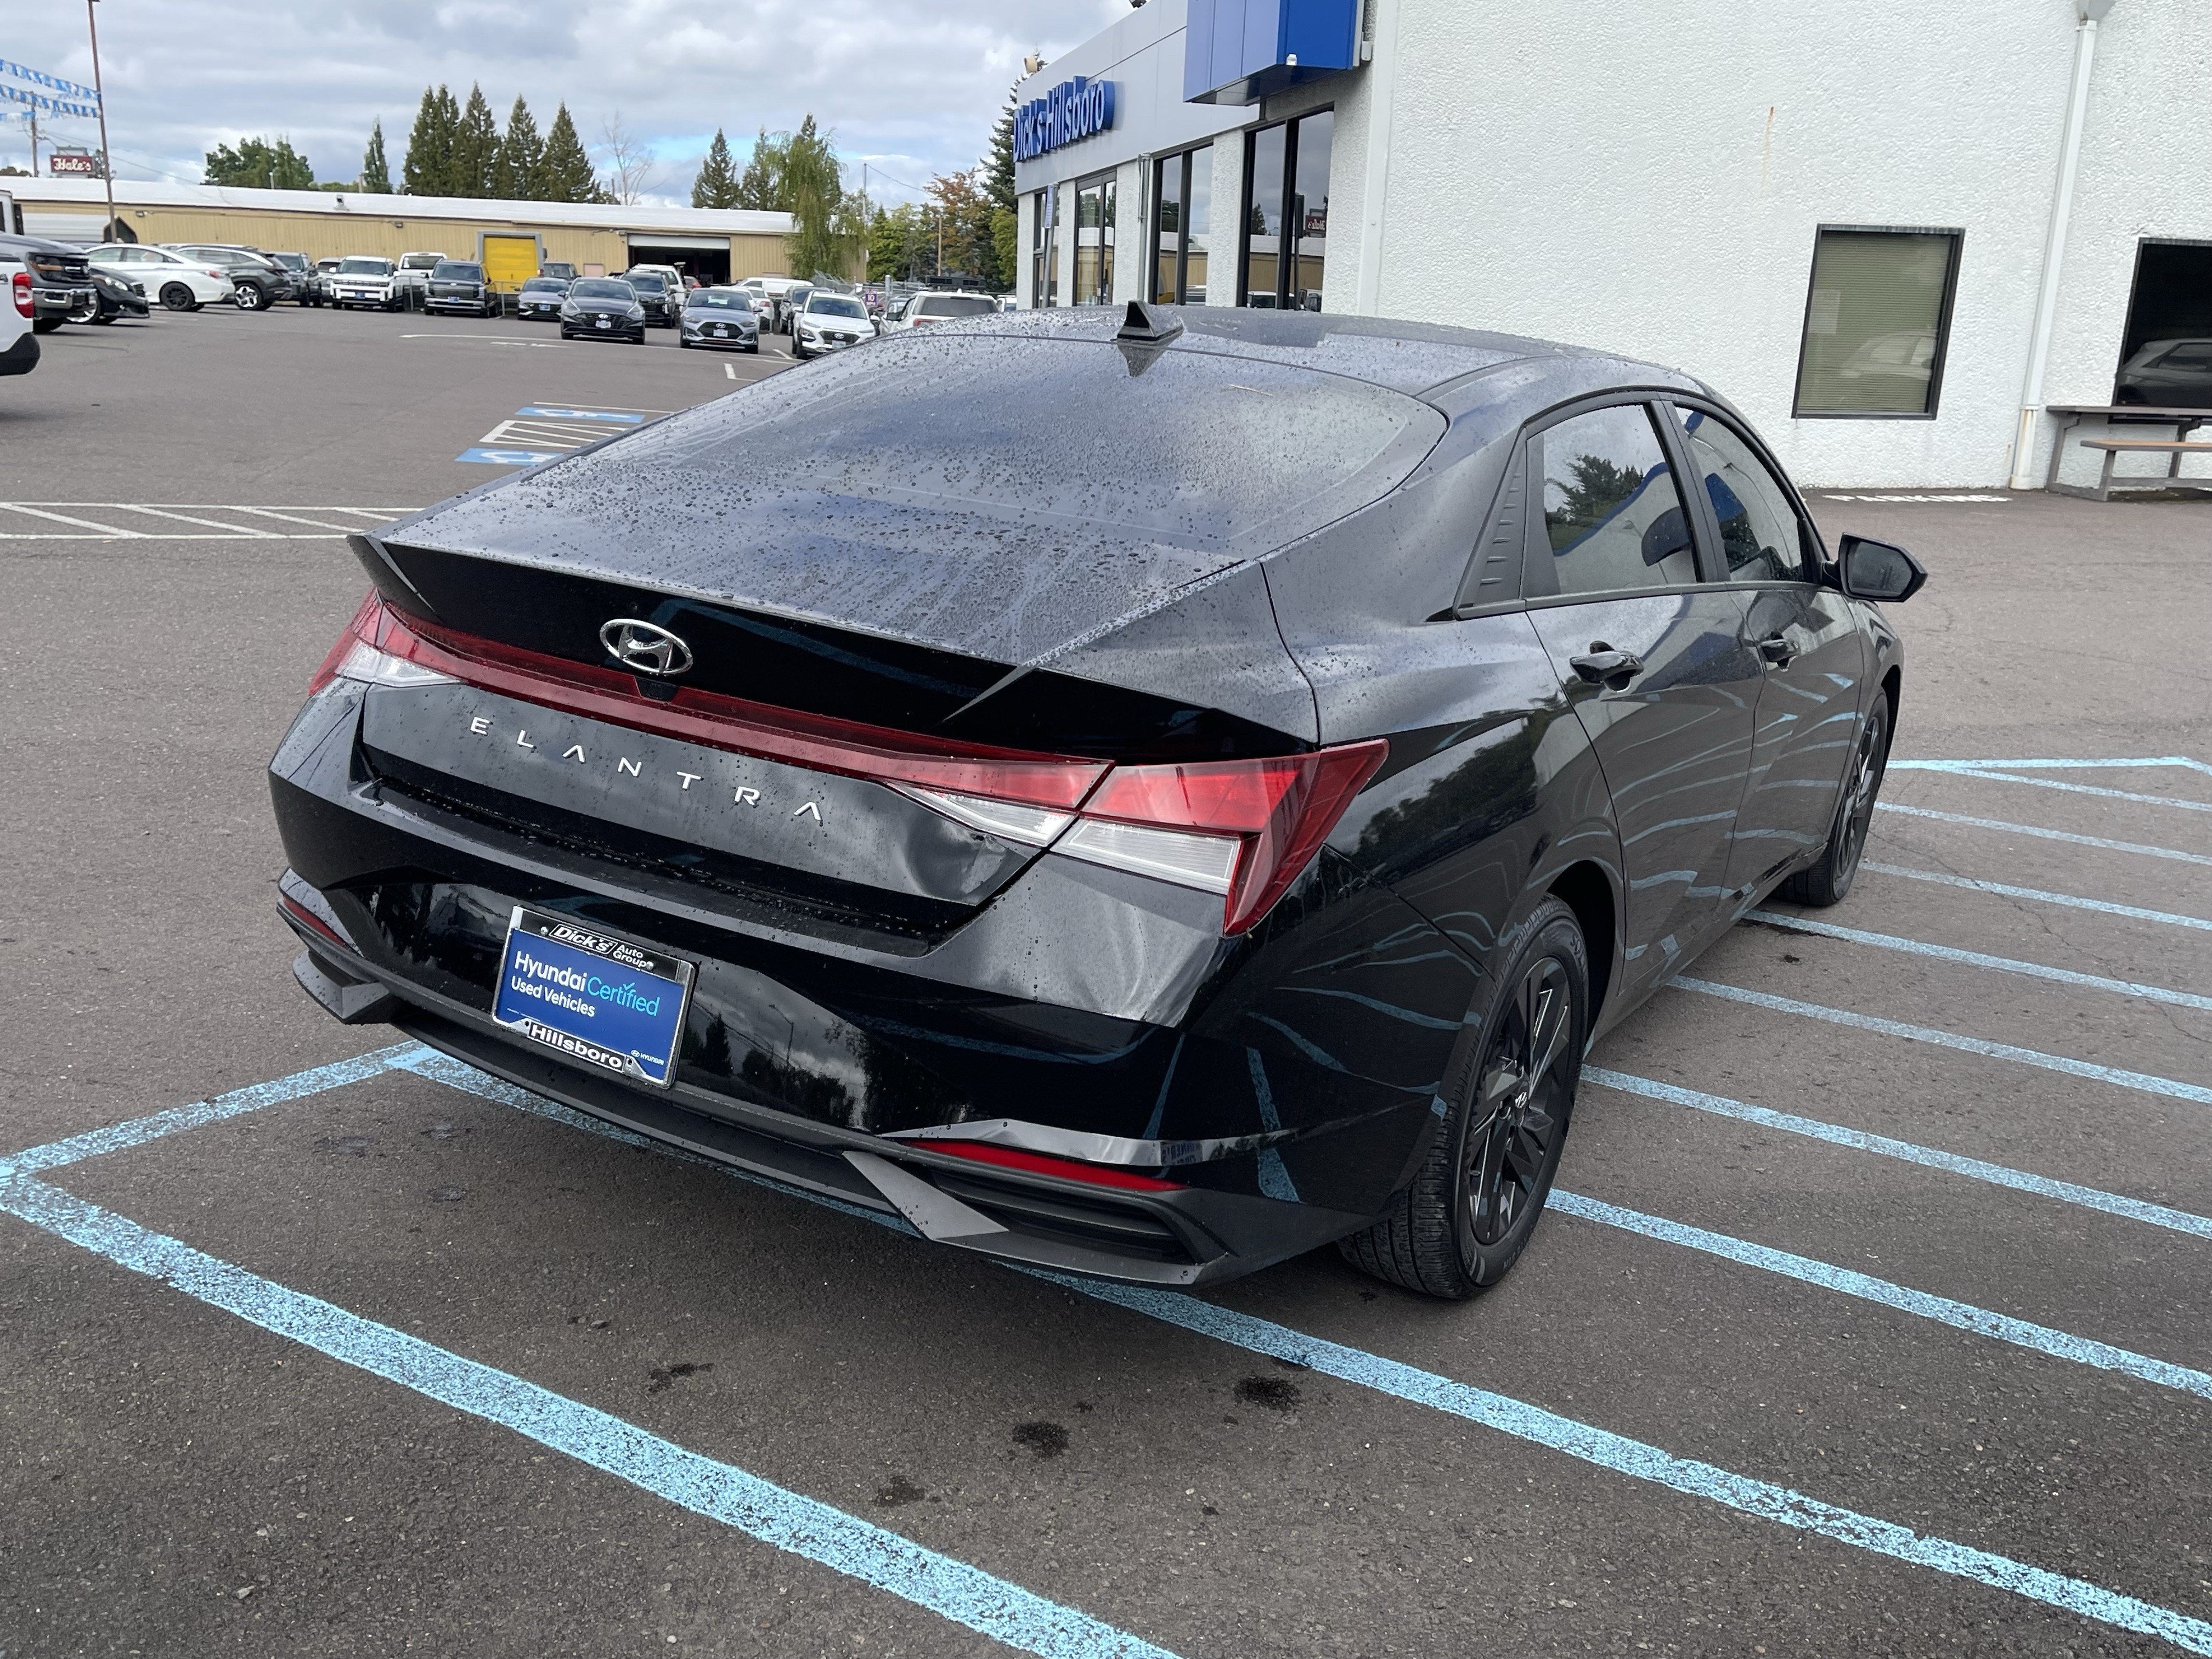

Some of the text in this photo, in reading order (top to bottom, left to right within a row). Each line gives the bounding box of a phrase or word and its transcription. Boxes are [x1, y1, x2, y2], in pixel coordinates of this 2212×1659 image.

[1013, 76, 1109, 163] Dick's Hillsboro
[53, 157, 92, 171] Hale's
[470, 716, 823, 822] ELANTRA
[553, 926, 609, 951] Dick's
[617, 944, 644, 958] Auto
[511, 975, 595, 1017] Used Vehicles
[515, 951, 660, 1016] Hyundai Certified
[531, 1024, 622, 1068] Hillsboro
